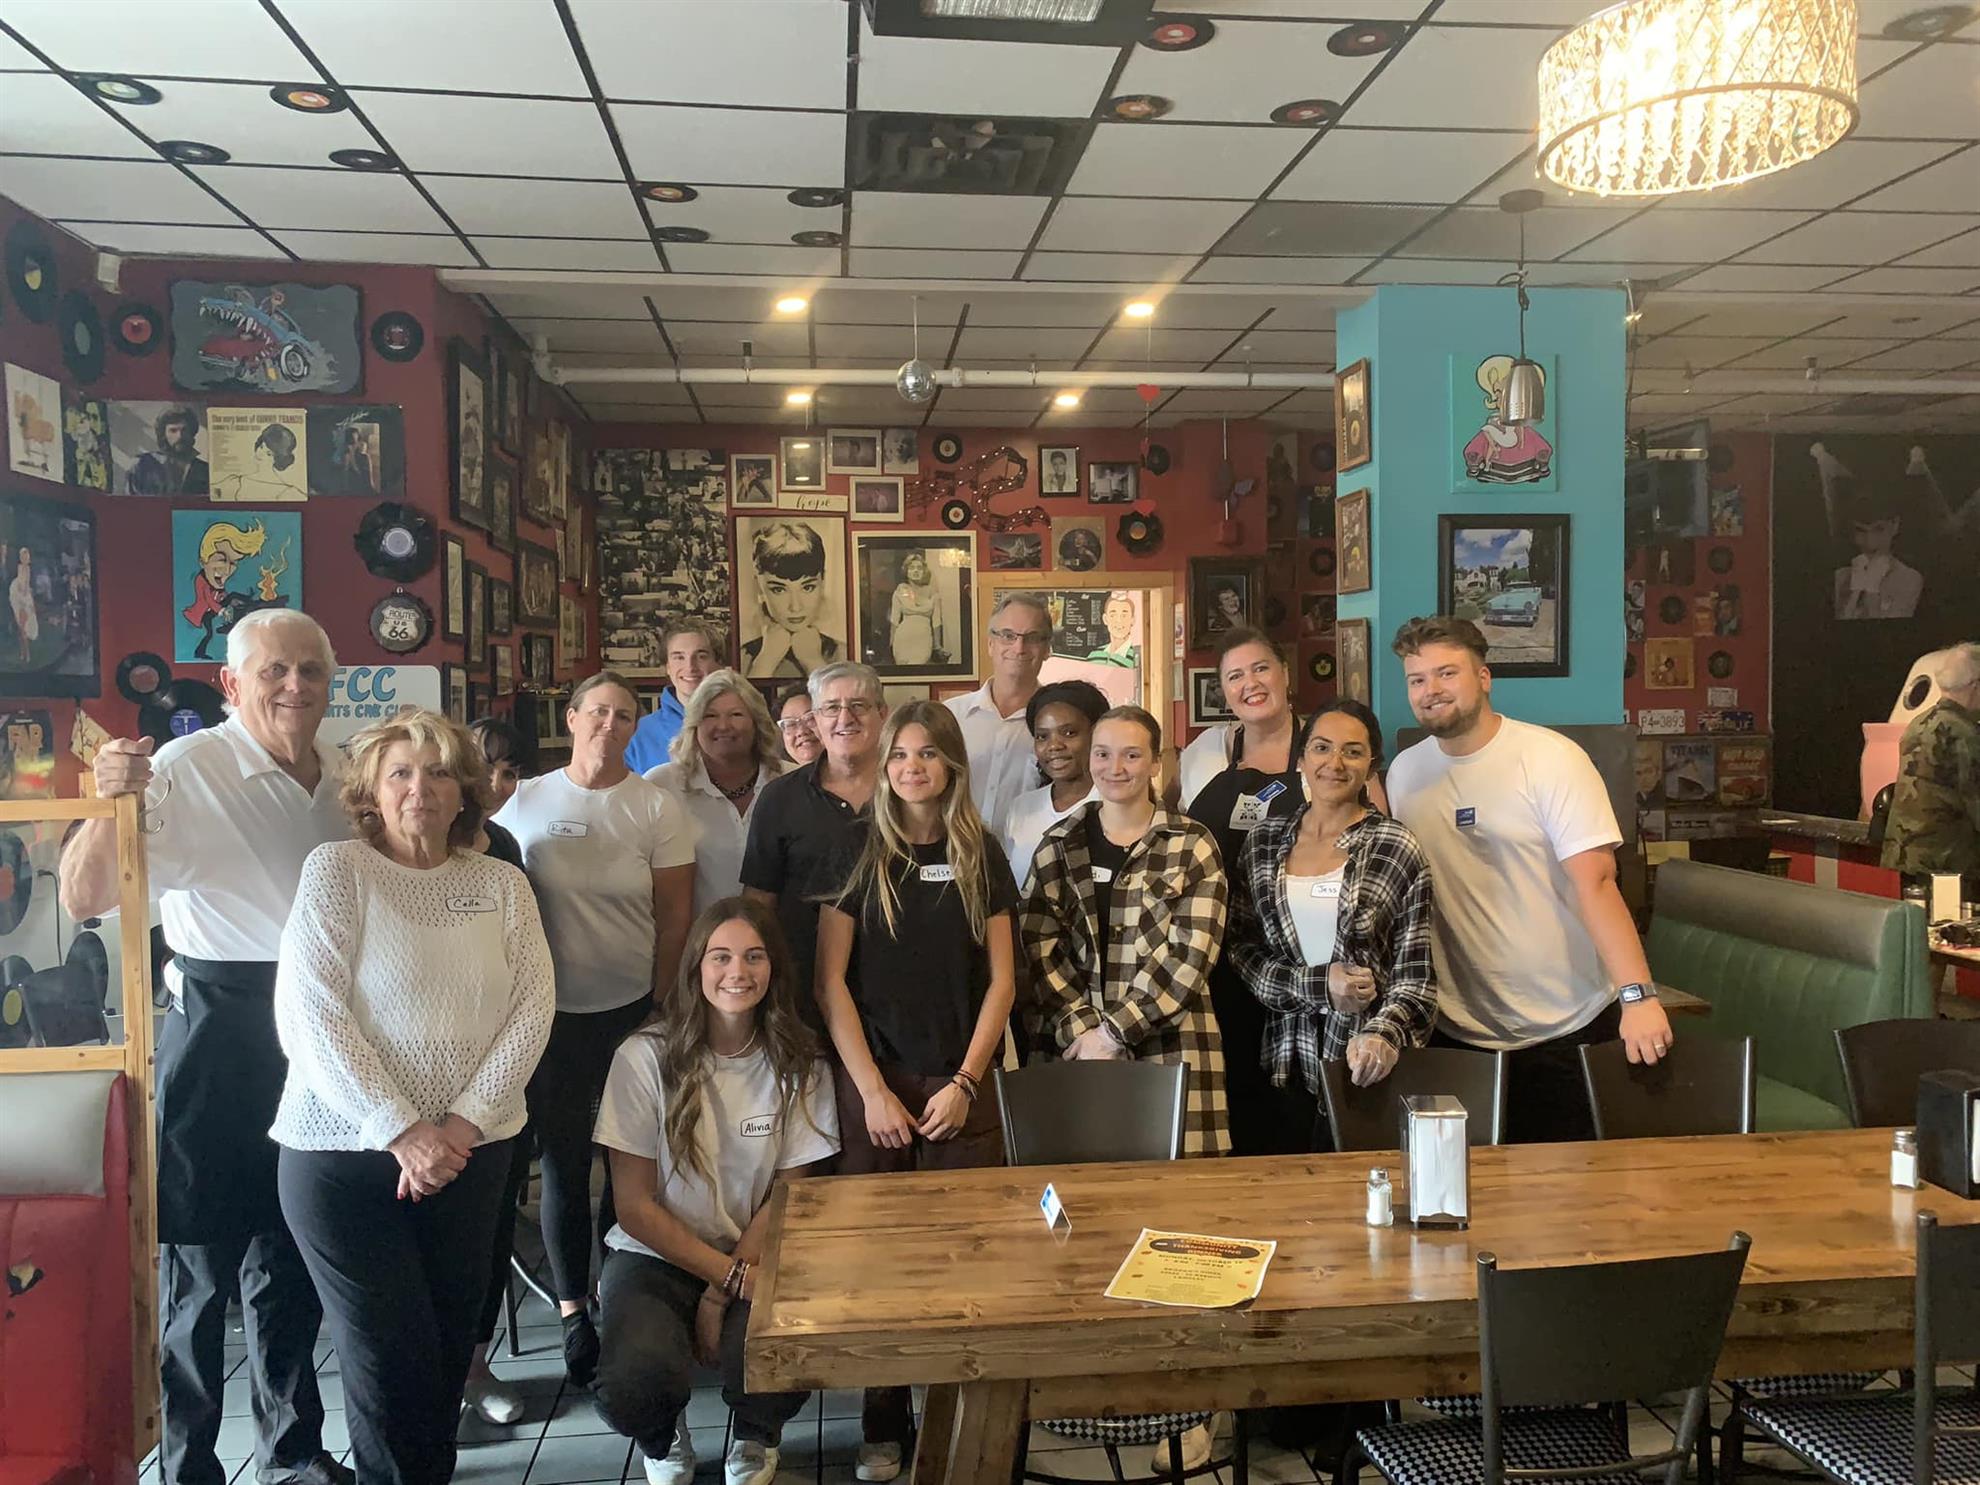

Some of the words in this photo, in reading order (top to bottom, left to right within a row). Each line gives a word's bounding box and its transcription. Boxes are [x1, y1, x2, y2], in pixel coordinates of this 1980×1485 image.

[389, 609, 416, 621] ROUTE
[388, 626, 409, 640] 66
[921, 868, 951, 879] Chelse
[744, 1122, 771, 1135] Alivia
